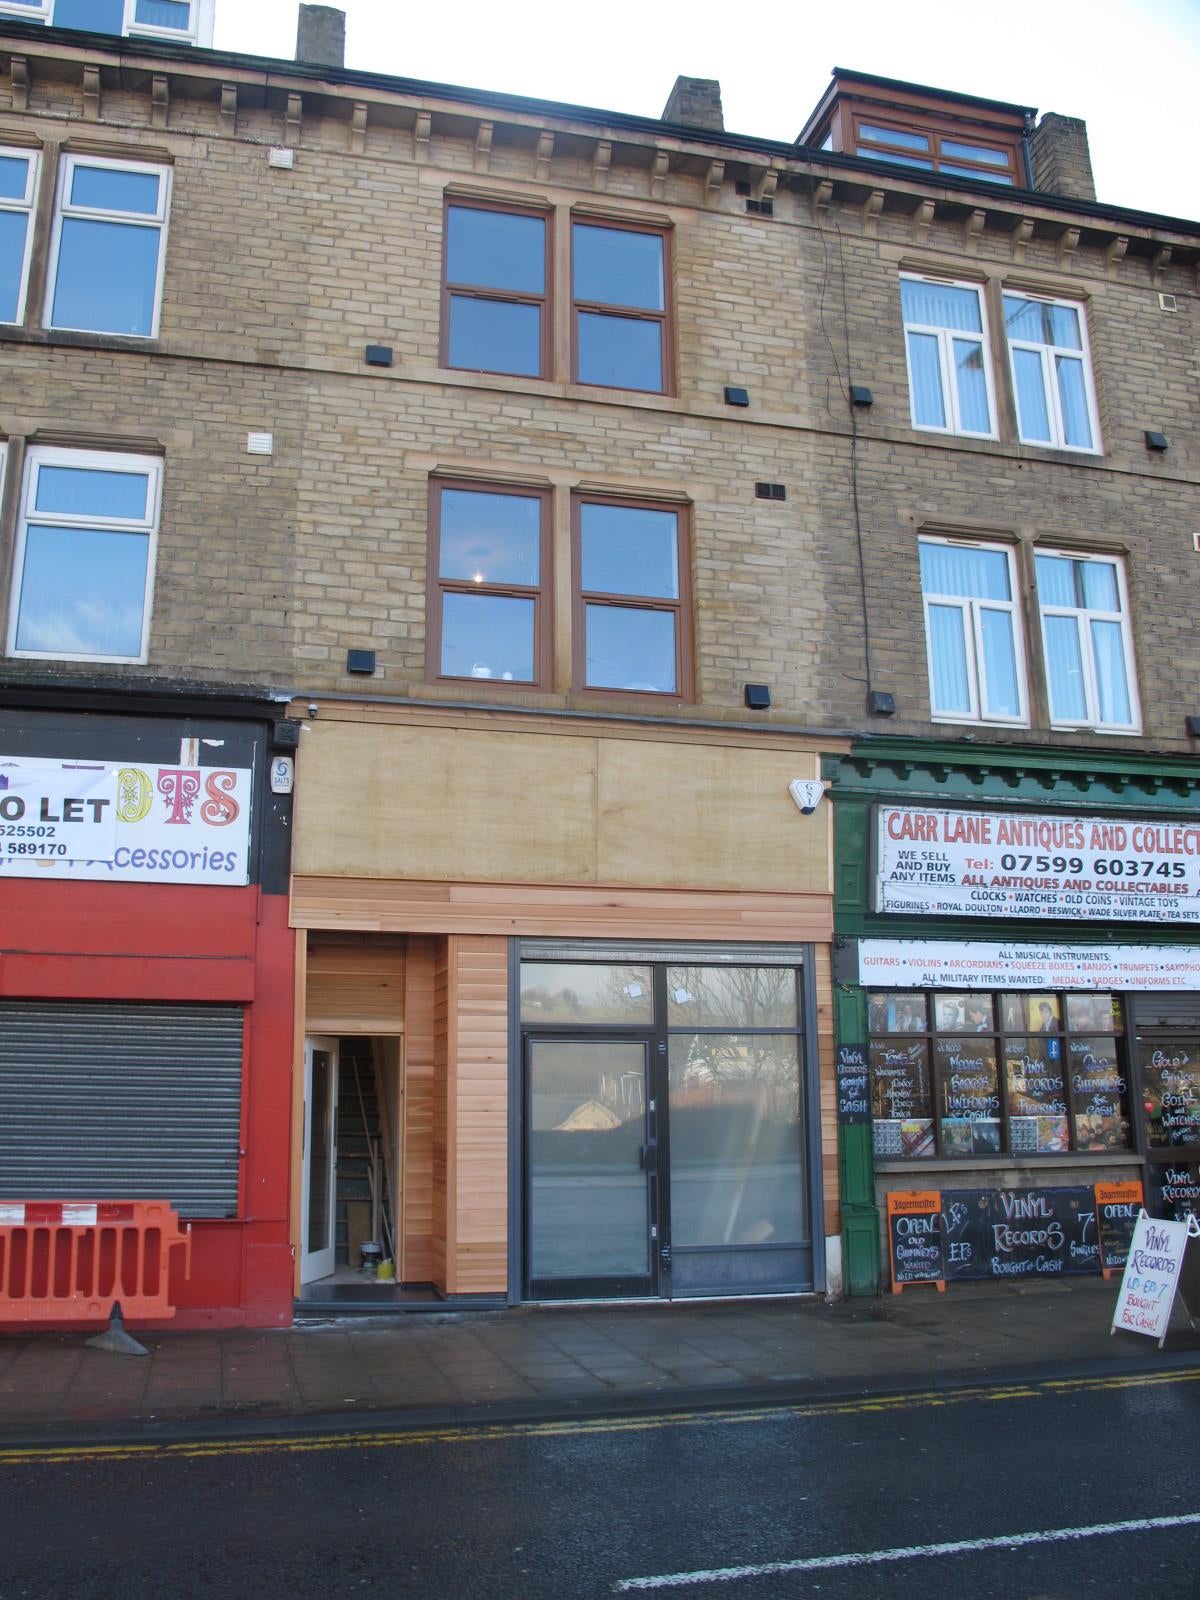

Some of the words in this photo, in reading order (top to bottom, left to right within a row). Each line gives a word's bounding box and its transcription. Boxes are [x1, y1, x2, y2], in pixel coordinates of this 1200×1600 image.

[40, 797, 110, 823] LET
[888, 812, 938, 842] CARR
[944, 815, 992, 844] LANE
[997, 819, 1085, 852] ANTIQUES
[1090, 824, 1128, 851] AND
[8, 843, 67, 855] 589170
[898, 850, 917, 860] WE
[921, 851, 949, 861] SELL
[86, 846, 237, 872] cessories
[896, 861, 923, 871] AND
[926, 863, 951, 872] BUY
[964, 858, 994, 870] Tel:
[1001, 854, 1083, 873] 07599
[1093, 859, 1186, 878] 603745
[890, 871, 915, 881] ANY
[919, 873, 956, 883] ITEMS
[961, 874, 987, 888] ALL
[990, 876, 1060, 890] ANTIQUES
[1062, 879, 1092, 891] AND
[1096, 880, 1189, 894] COLLECTABLES
[971, 890, 1007, 901] CLOCKS
[1014, 892, 1058, 903] WATCHES
[1065, 894, 1083, 904] OLD
[1085, 895, 1112, 905] COINS
[1119, 896, 1156, 907] VINTAGE
[1158, 898, 1179, 908] TOYS
[886, 900, 930, 910] FIGURINES
[936, 902, 962, 911] ROYAL
[965, 903, 1003, 913] DOULTON
[1010, 905, 1041, 914] LLADRO
[1047, 906, 1082, 916] BESWICK
[1088, 908, 1111, 917] WADE
[1112, 909, 1138, 918] SILVER
[1139, 910, 1161, 919] PLATE
[1167, 911, 1182, 919] TEA
[1182, 911, 1199, 920] SETS
[863, 957, 900, 966] GUITARS
[908, 959, 942, 968] VIOLINS
[1010, 961, 1047, 970] SQUEEZE
[1048, 962, 1075, 971] BOXES
[1081, 962, 1112, 971] BANJOS
[1119, 963, 1159, 971] TRUMPETS
[998, 950, 1014, 959] ALL
[1015, 951, 1051, 960] MUSICAL
[1053, 952, 1112, 961] INSTRUMENTS:
[922, 973, 937, 982] ALL
[940, 974, 979, 983] MILITARY
[981, 975, 1007, 983] ITEMS
[1008, 975, 1046, 984] WANTED:
[1052, 976, 1085, 985] MEDALS
[1092, 976, 1123, 985] BADGES
[1130, 977, 1170, 985] UNIFORMS
[1172, 977, 1186, 985] ETC
[840, 1048, 865, 1064] VINYL
[1024, 1056, 1048, 1073] VINYL
[1152, 1051, 1180, 1068] GOLD
[1013, 1075, 1064, 1092] RECORDS
[840, 1099, 867, 1112] CASH
[948, 1094, 1000, 1109] UNIFORMS
[1165, 1168, 1194, 1184] VINYL
[1001, 1192, 1053, 1218] VINYL
[908, 1236, 925, 1245] OLD
[992, 1222, 1064, 1251] RECORDS
[1146, 1226, 1170, 1252] VINYL
[991, 1256, 1029, 1273] BOUGHT
[1036, 1255, 1064, 1271] CASH
[1131, 1250, 1175, 1274] RECORDS
[1126, 1293, 1160, 1311] BOUGHT
[1135, 1311, 1159, 1331] CASH!
